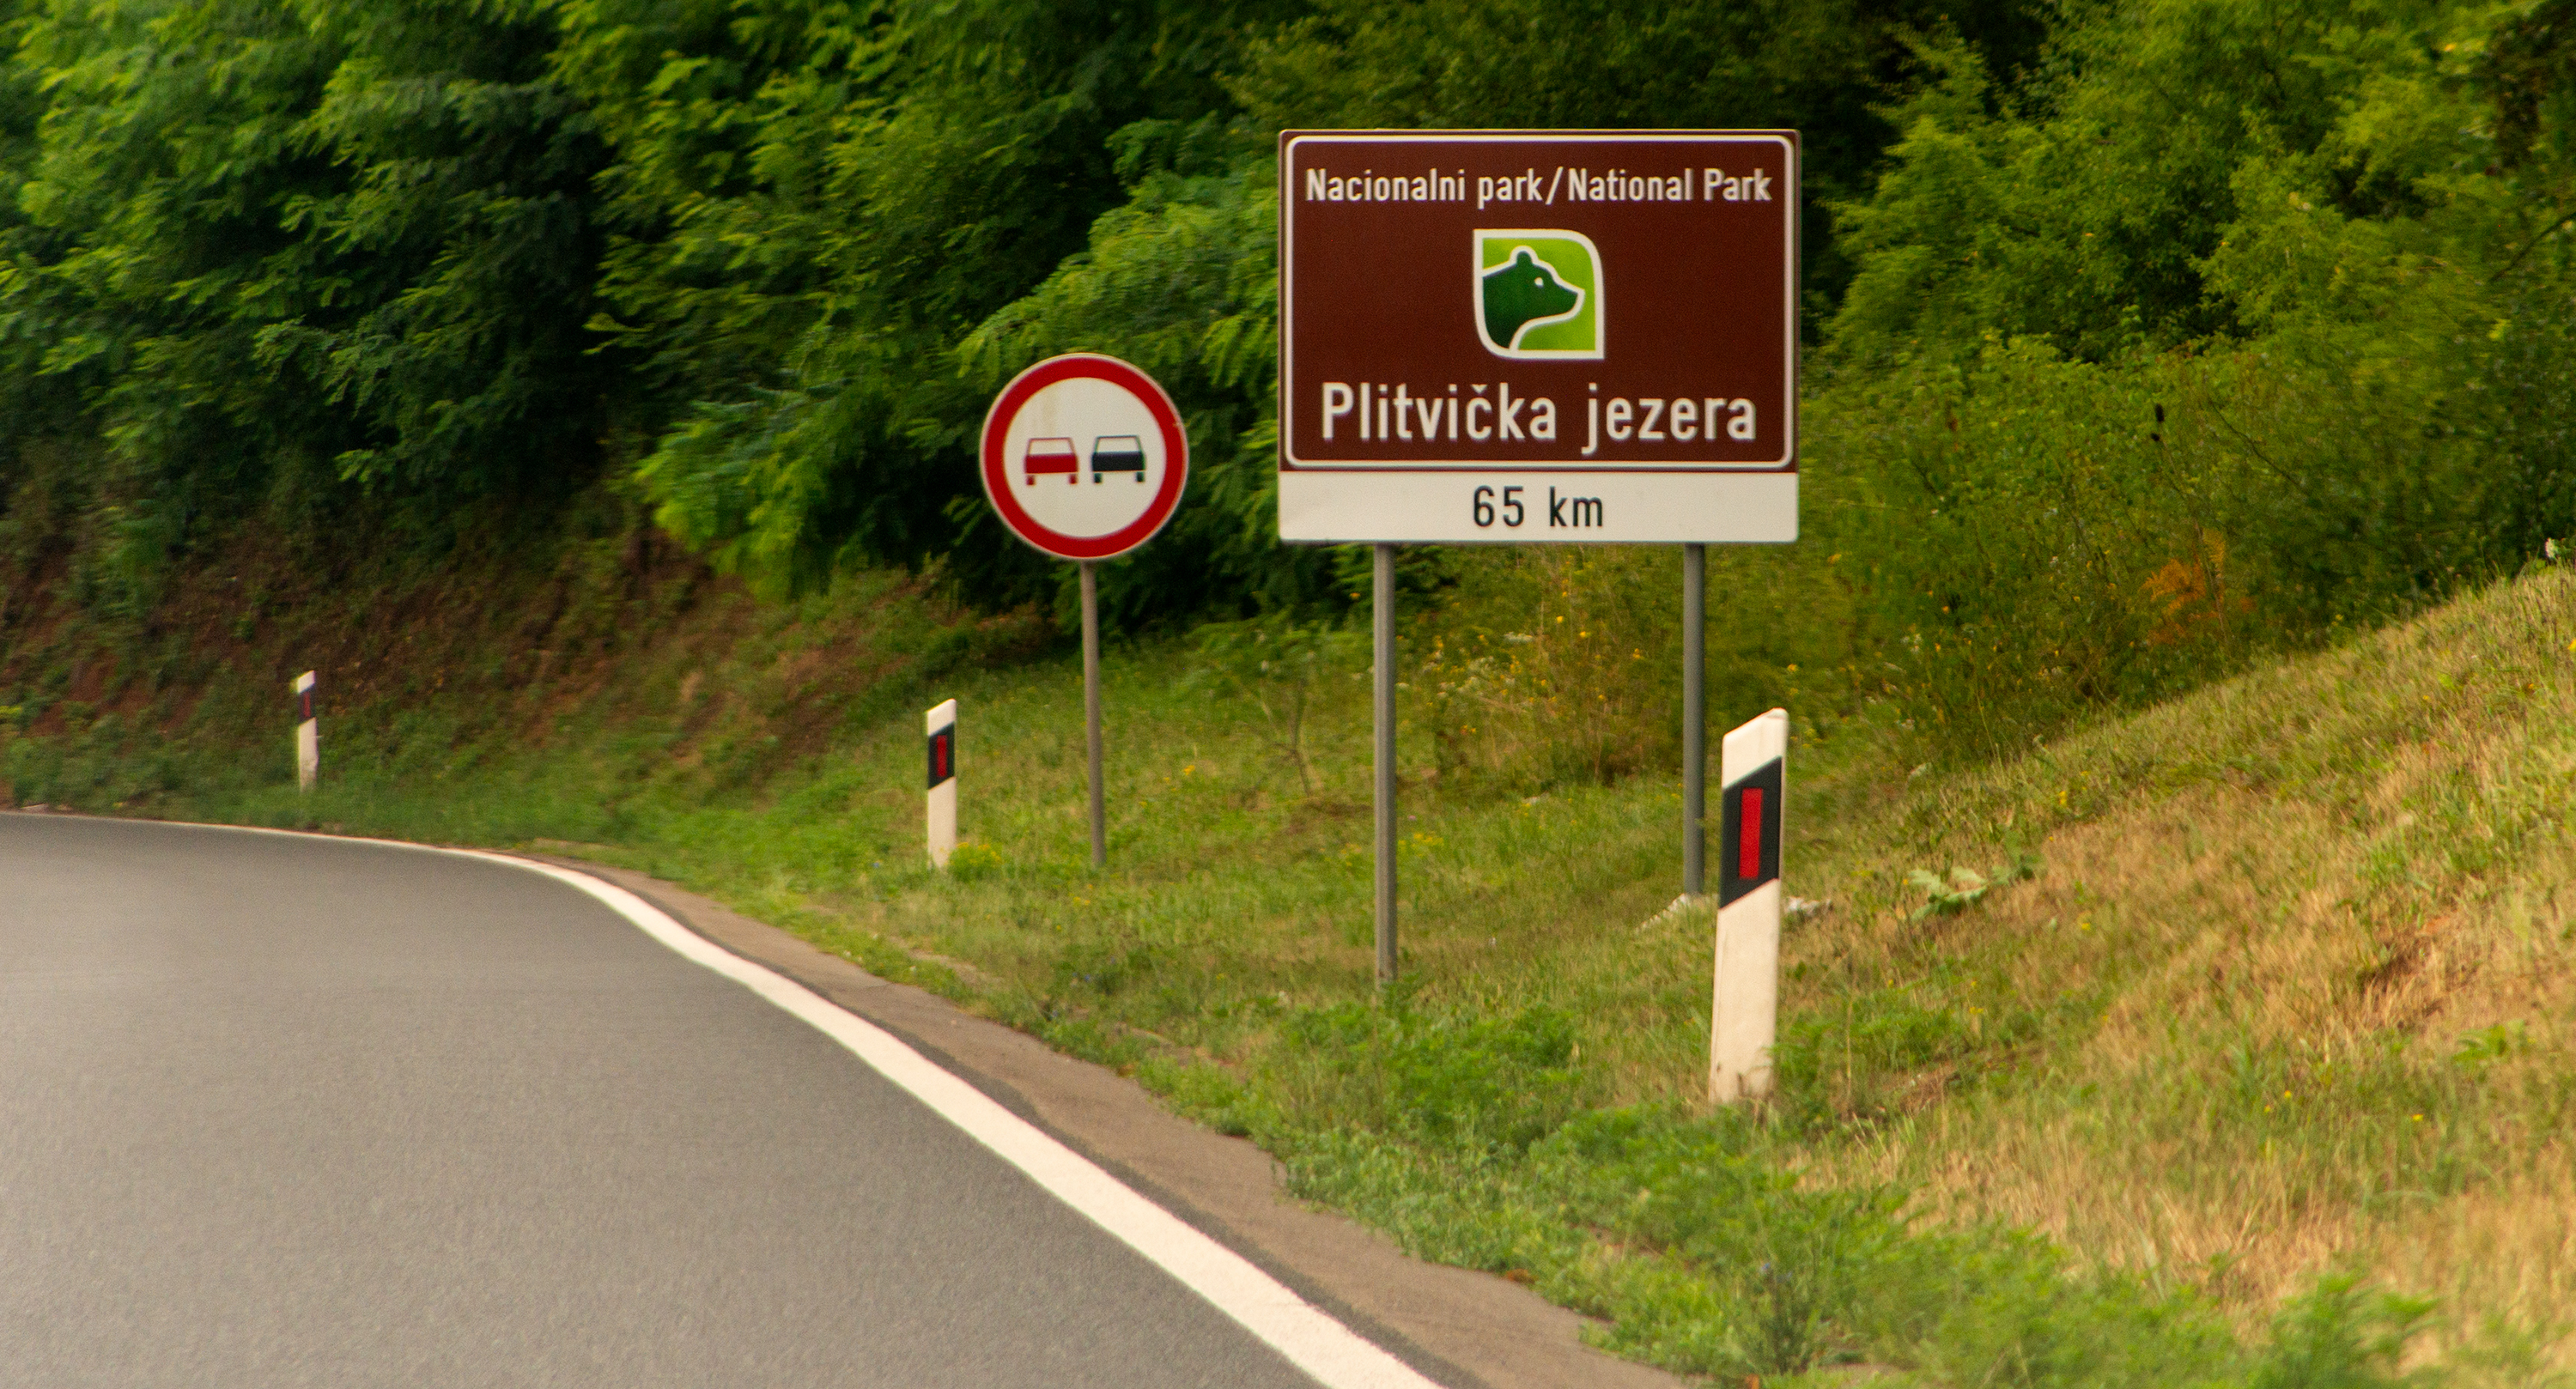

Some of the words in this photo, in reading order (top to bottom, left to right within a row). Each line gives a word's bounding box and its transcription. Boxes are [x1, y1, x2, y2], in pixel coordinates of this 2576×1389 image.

[1306, 168, 1466, 202] Nacionalni
[1704, 168, 1771, 202] Park
[1321, 383, 1556, 441] Plitvička
[1581, 382, 1755, 456] jezera
[1473, 485, 1525, 528] 65
[1548, 486, 1604, 528] km
